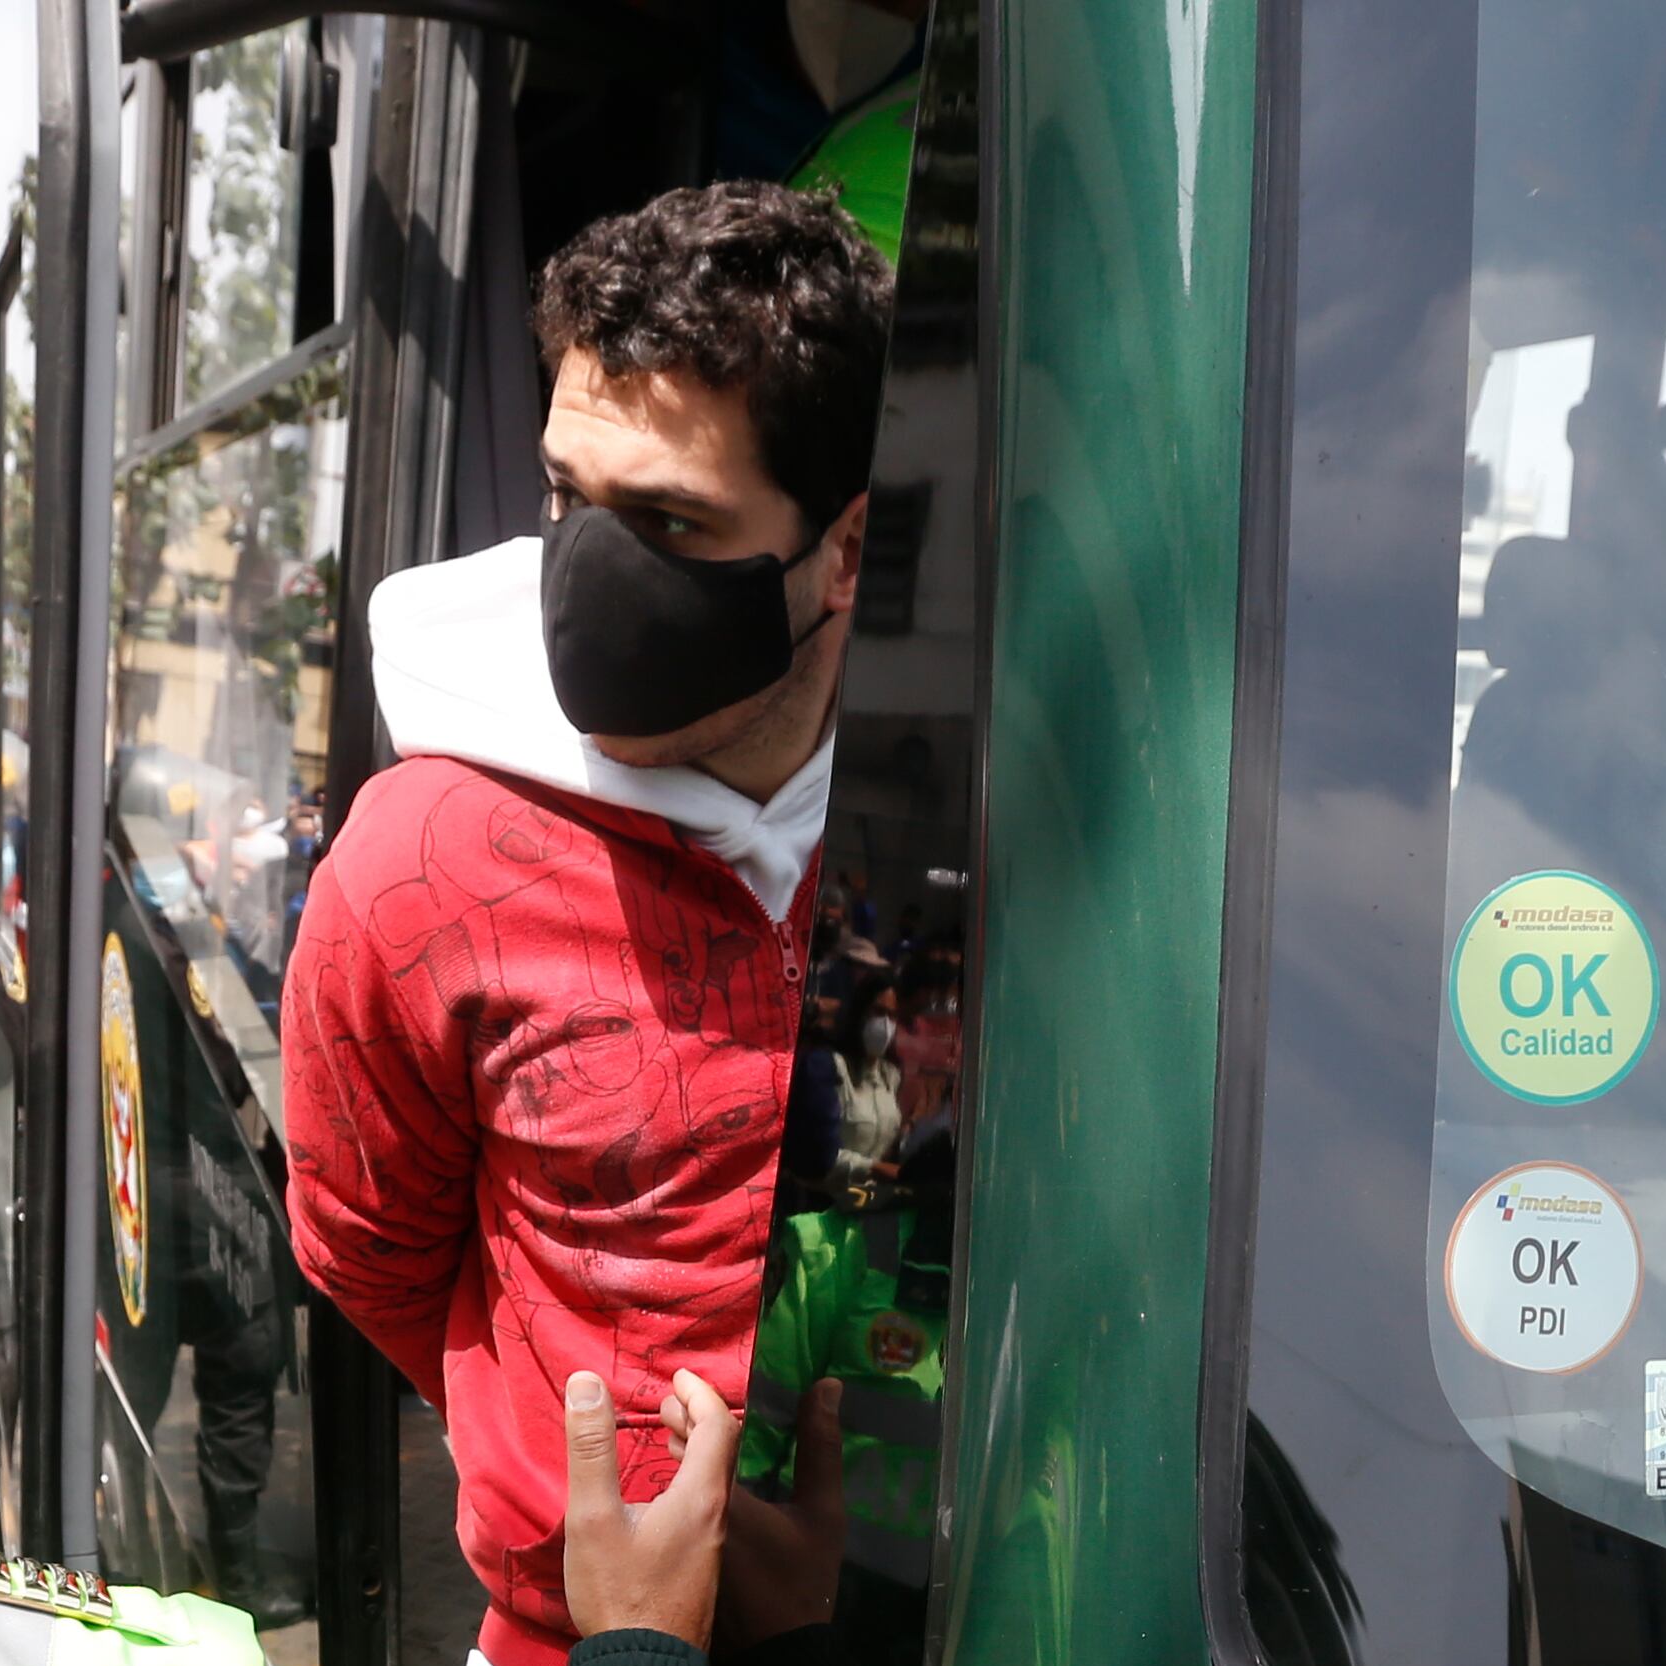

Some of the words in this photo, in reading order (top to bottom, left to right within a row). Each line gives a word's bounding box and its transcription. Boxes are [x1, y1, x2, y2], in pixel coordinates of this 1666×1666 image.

[1512, 905, 1614, 923] modasa
[1499, 953, 1612, 1018] OK
[1500, 1028, 1613, 1056] Calidad
[1518, 1195, 1603, 1214] modasa
[1512, 1237, 1581, 1286] OK
[1519, 1306, 1566, 1336] PDI
